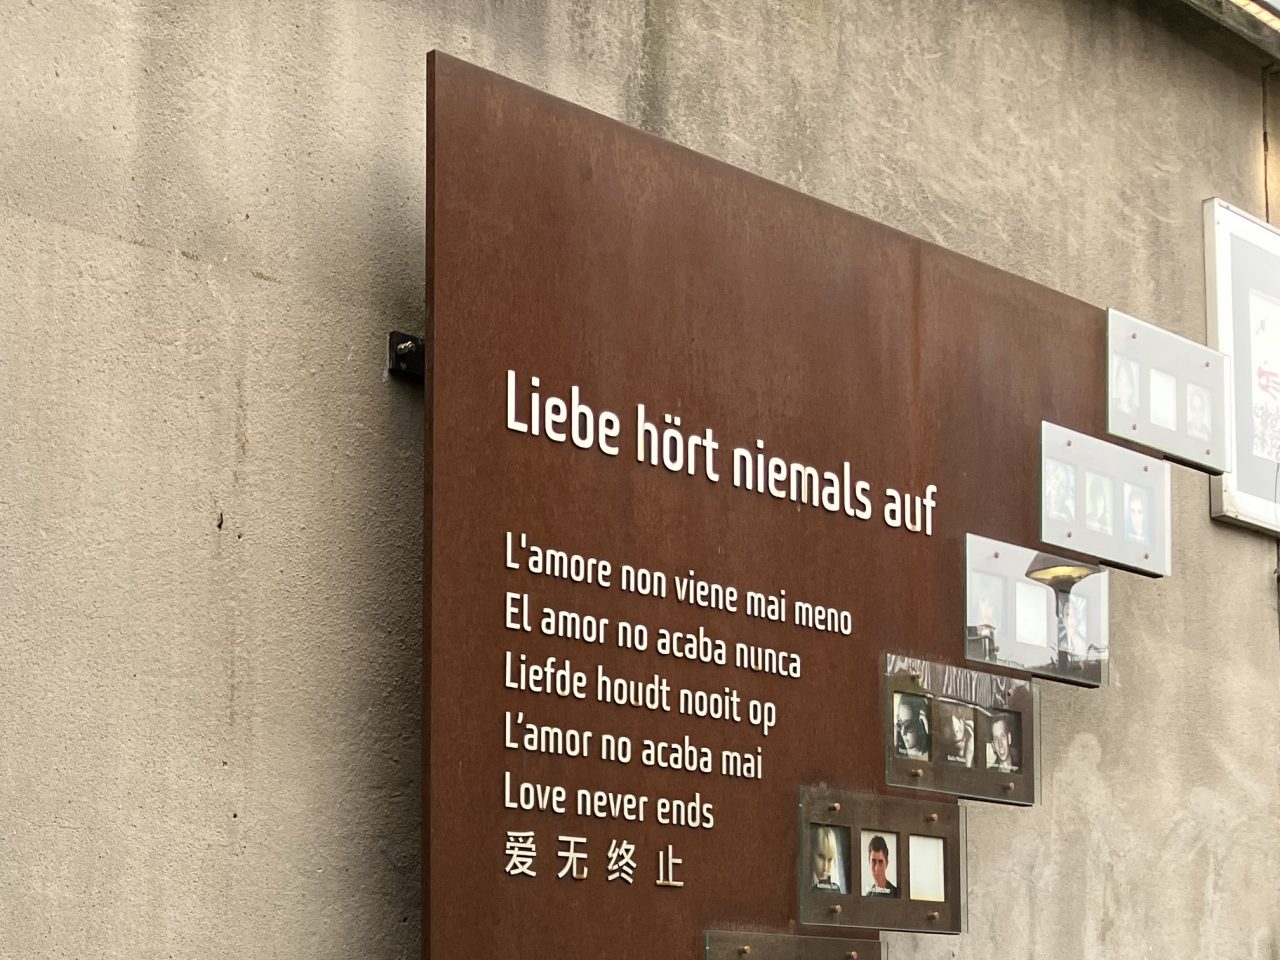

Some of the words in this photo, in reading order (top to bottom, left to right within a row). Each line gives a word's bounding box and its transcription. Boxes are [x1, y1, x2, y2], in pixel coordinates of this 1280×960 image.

[508, 370, 620, 455] Liebe
[638, 404, 719, 481] hört
[734, 439, 871, 519] niemals
[884, 485, 937, 535] auf
[506, 592, 531, 631] El
[541, 608, 609, 643] amor
[619, 622, 647, 650] no
[657, 627, 726, 664] acaba
[736, 643, 800, 677] nunca
[622, 565, 666, 597] non
[675, 570, 737, 612] viene
[747, 590, 785, 621] mai
[795, 602, 851, 634] meno
[506, 651, 586, 698] Liefde
[598, 665, 670, 711] houdt
[680, 687, 741, 721] nooit
[750, 700, 775, 735] op
[602, 734, 631, 763] no
[642, 736, 712, 772] acaba
[722, 747, 761, 778] mai
[505, 772, 566, 813] Love
[578, 790, 648, 821] never
[657, 793, 714, 828] ends
